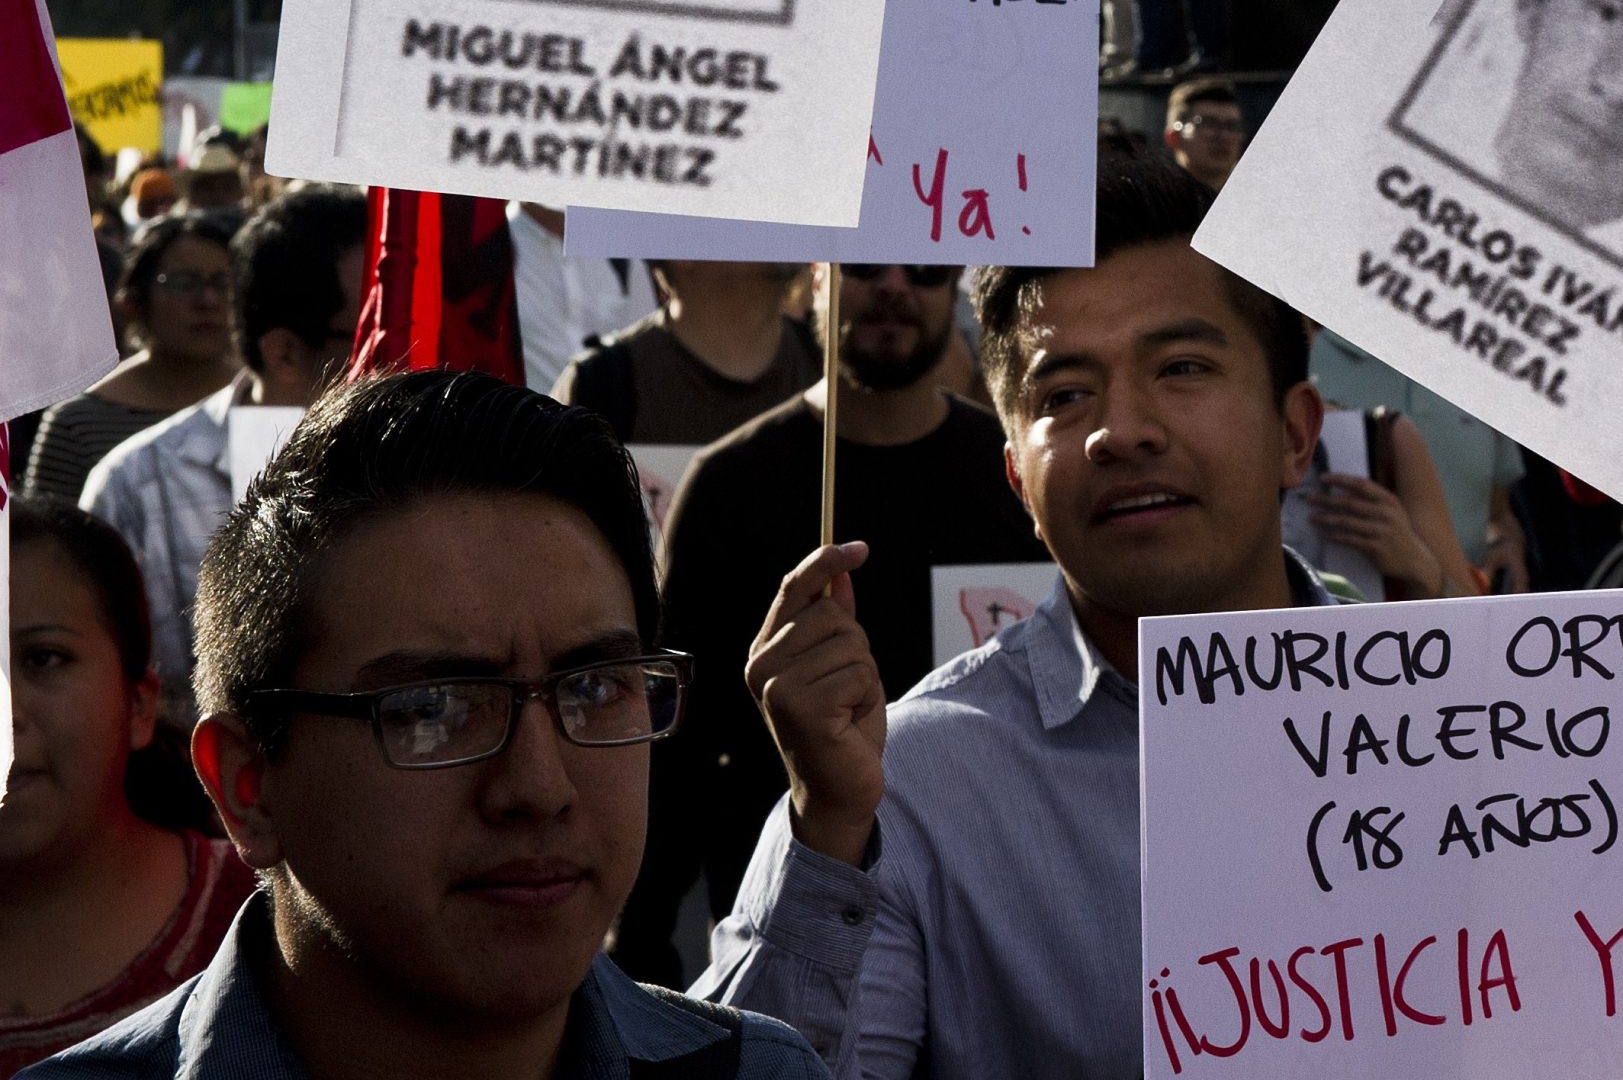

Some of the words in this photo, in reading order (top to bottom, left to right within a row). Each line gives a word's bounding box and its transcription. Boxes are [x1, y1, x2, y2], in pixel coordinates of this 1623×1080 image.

[401, 18, 595, 78] MIGUEL
[609, 30, 780, 93] ÁNGEL
[427, 72, 748, 139] HERNÁNDEZ
[449, 125, 716, 187] MARTÍNEZ
[1376, 165, 1541, 280] CARLOS
[1356, 249, 1568, 408] VILLAREAL
[1394, 227, 1581, 356] RAMÍREZ
[1155, 627, 1452, 705] MAURICIO
[1282, 700, 1611, 777] VALERIO
[1306, 801, 1405, 891] (18
[1438, 778, 1619, 859] AÑOS)
[1149, 927, 1522, 1074] ¡¡JUSTICIA
